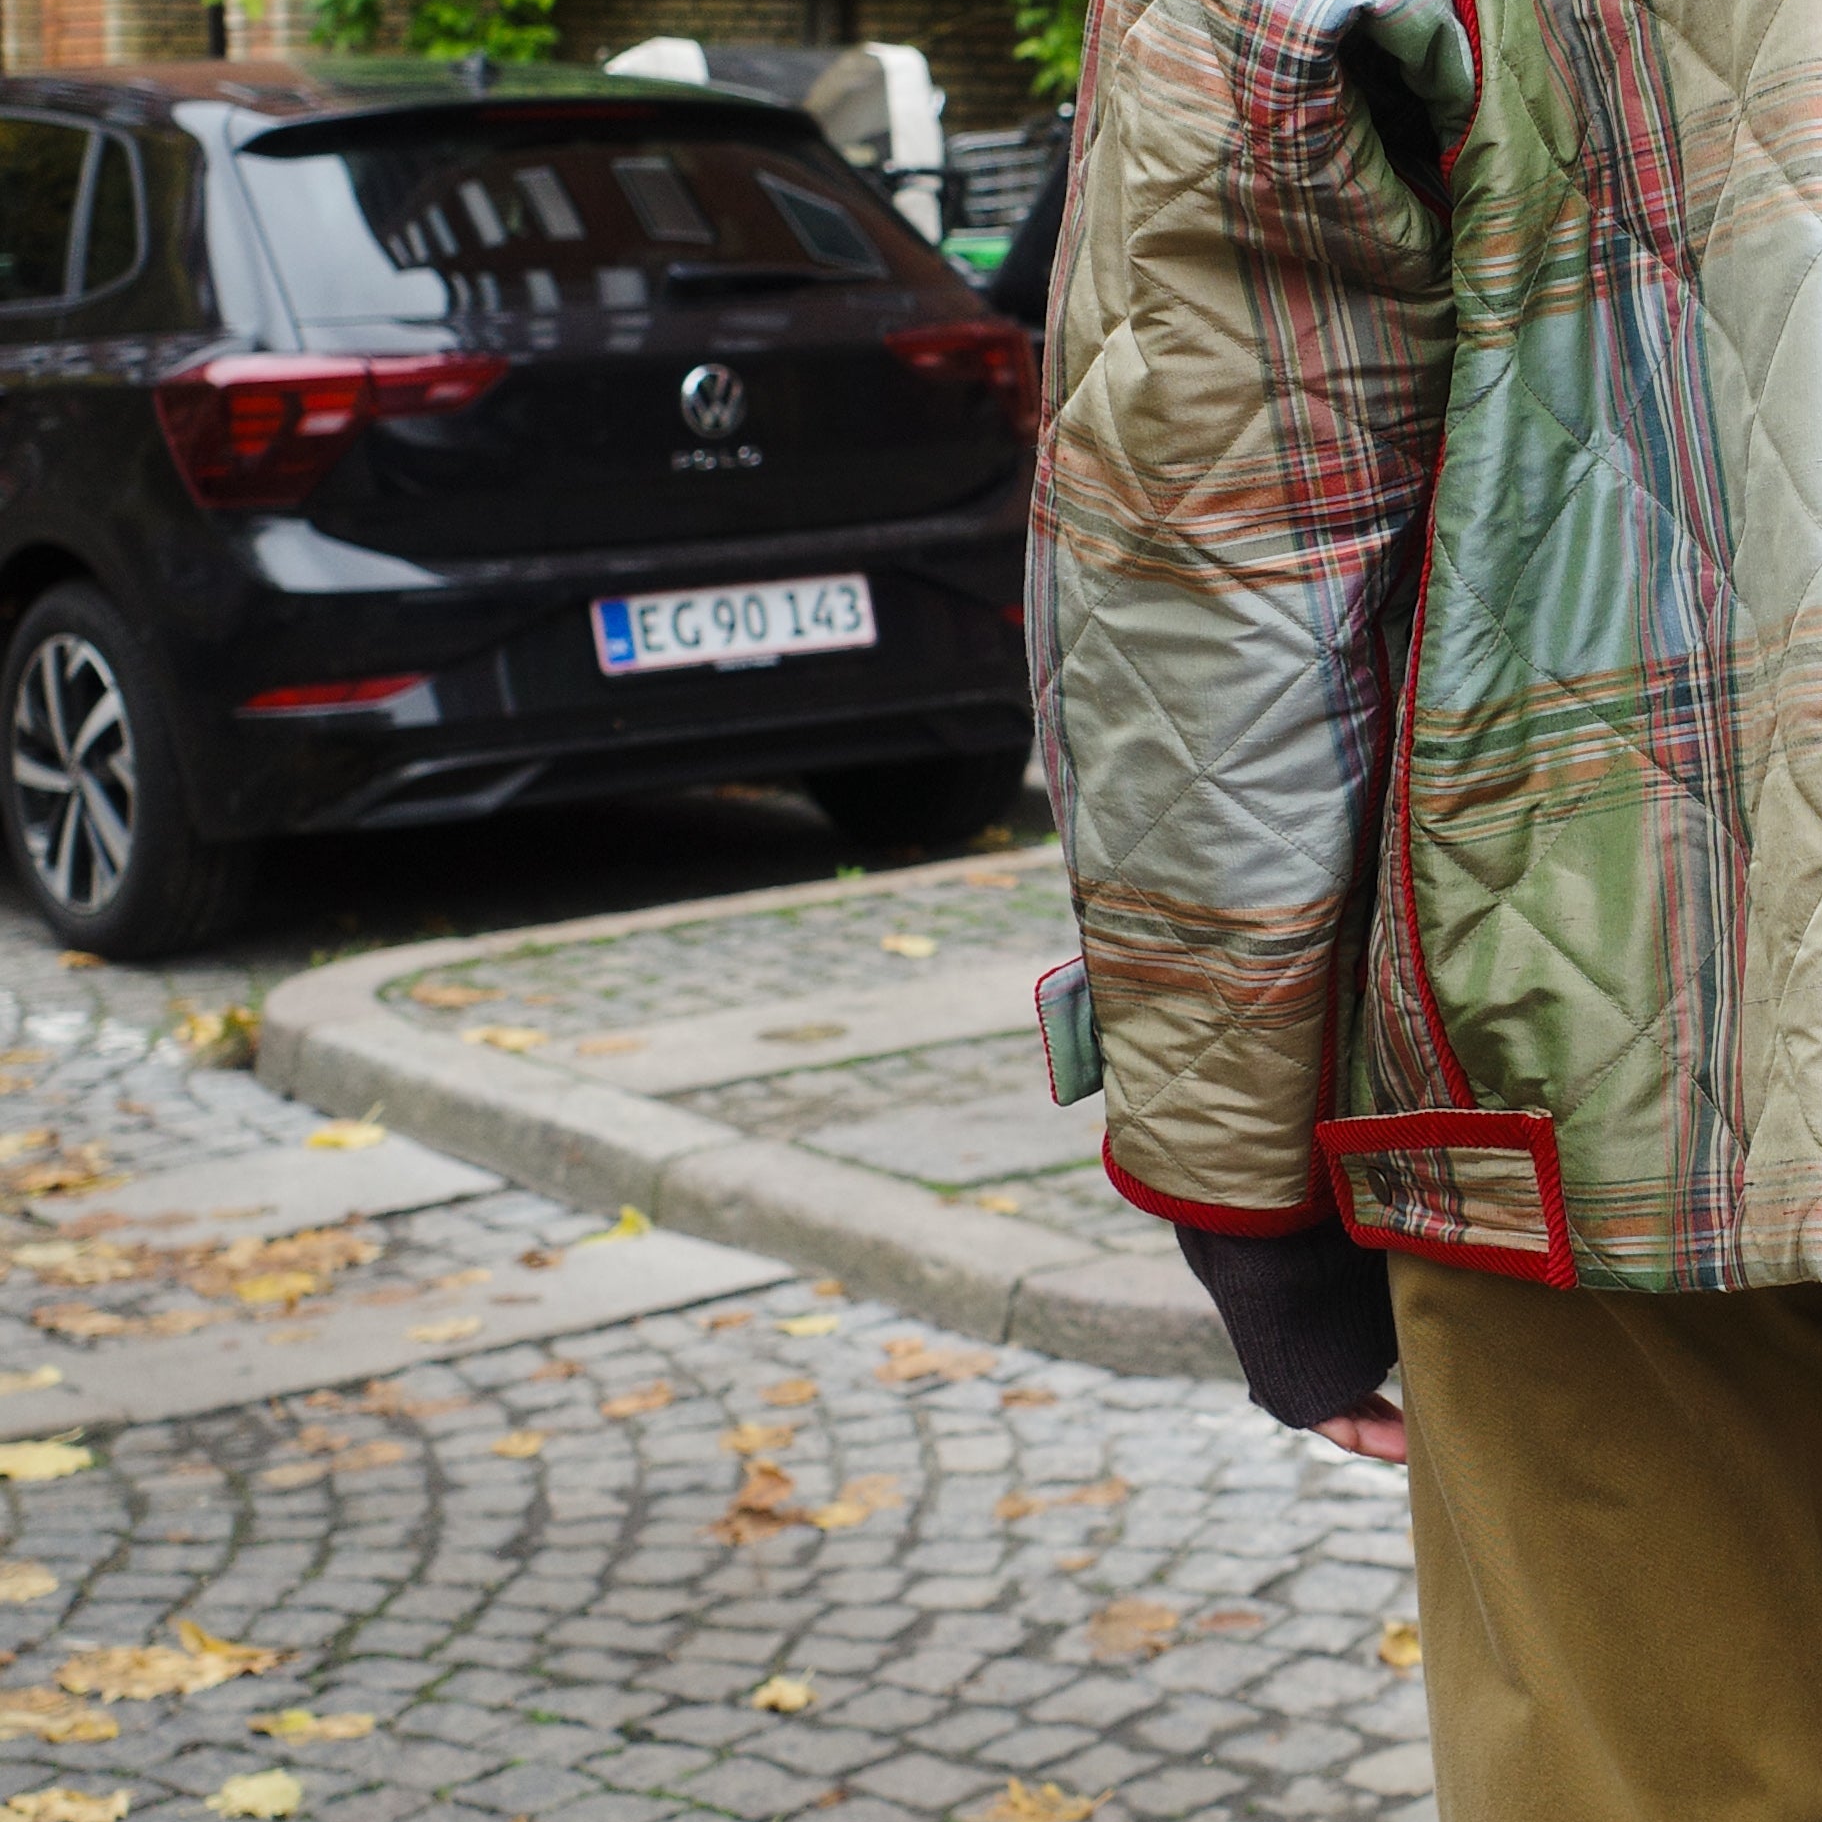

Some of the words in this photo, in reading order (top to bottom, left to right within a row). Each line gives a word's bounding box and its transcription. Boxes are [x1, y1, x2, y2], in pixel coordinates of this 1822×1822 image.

[637, 599, 702, 652] EG
[713, 592, 768, 646] 90
[784, 584, 863, 637] 143
